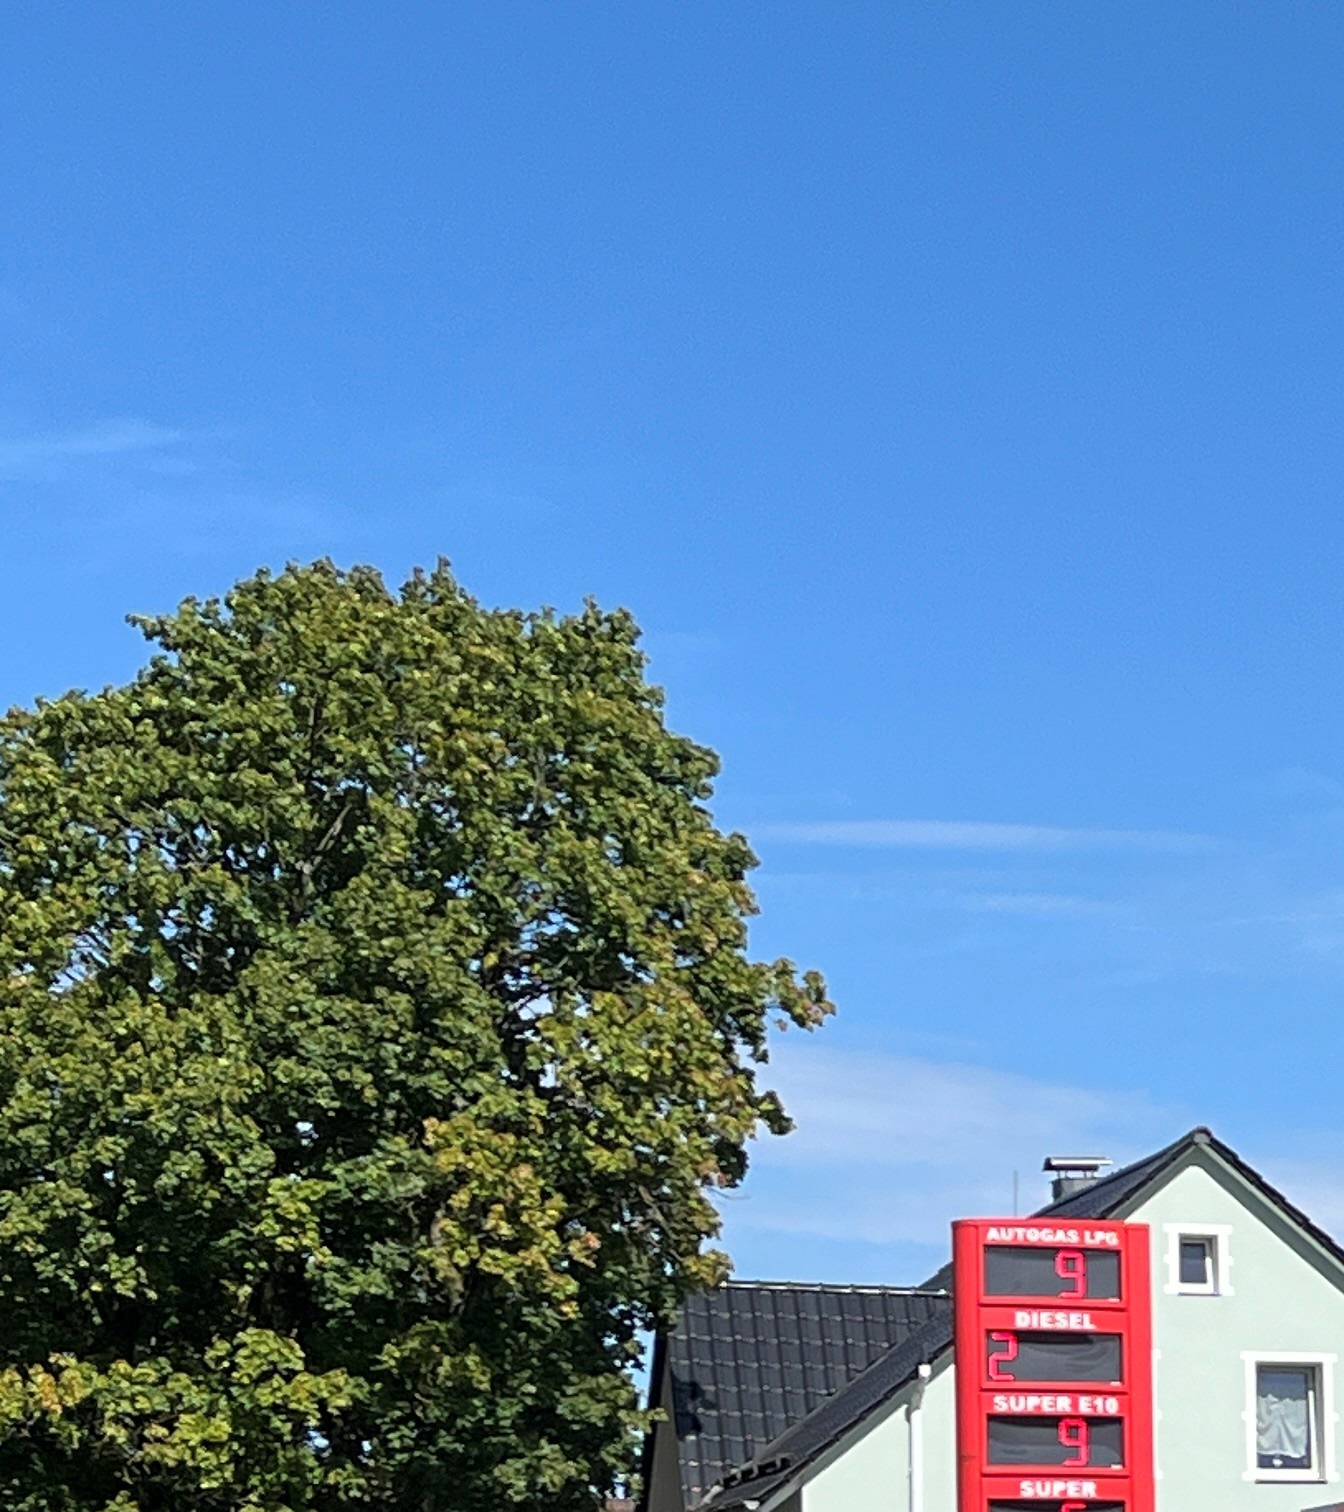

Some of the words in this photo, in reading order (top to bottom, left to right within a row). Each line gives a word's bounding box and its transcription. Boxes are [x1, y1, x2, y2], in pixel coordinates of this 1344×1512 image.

[986, 1227, 1080, 1243] AUTOGAS
[1084, 1230, 1119, 1245] LPG
[1014, 1311, 1097, 1330] DIESEL
[988, 1331, 1019, 1382] 2
[993, 1395, 1073, 1413] SUPER
[1078, 1396, 1119, 1415] E10
[1019, 1480, 1097, 1498] SUPER
